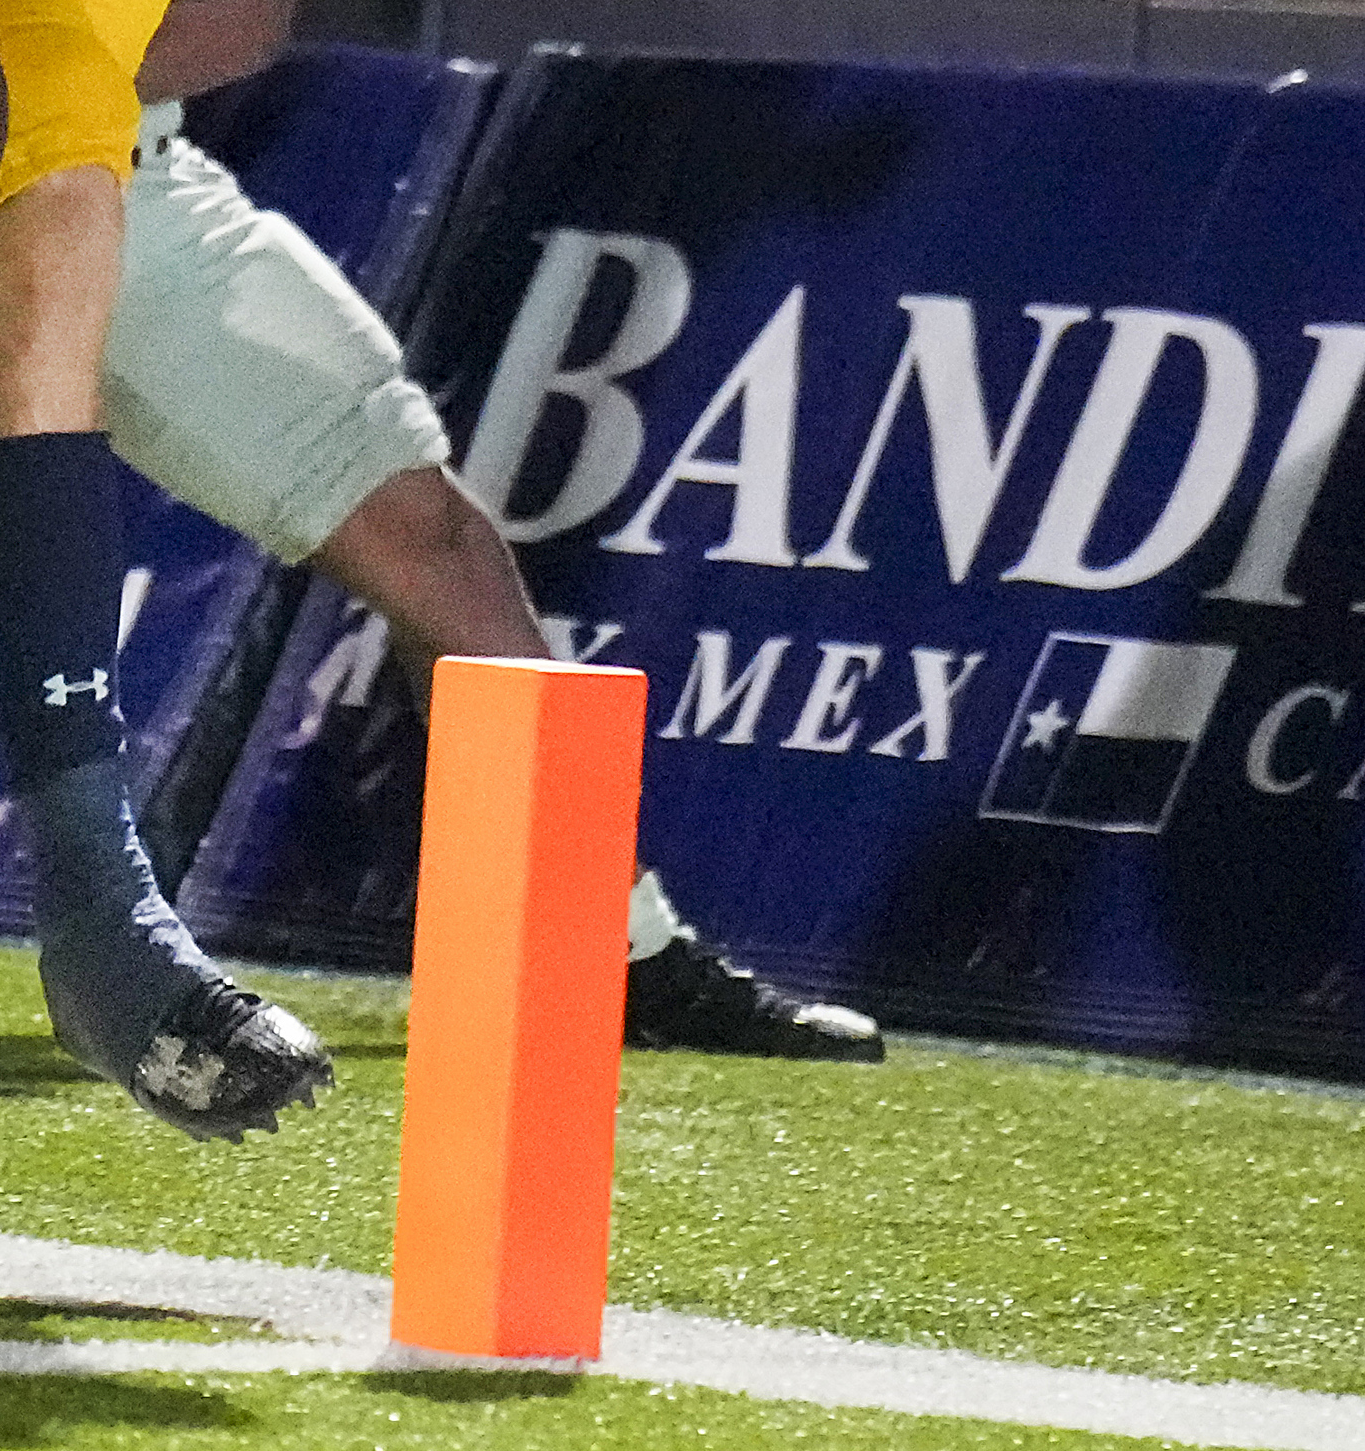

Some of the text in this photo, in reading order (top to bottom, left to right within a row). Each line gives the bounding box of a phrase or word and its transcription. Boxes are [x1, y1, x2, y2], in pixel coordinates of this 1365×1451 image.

[469, 228, 1365, 608] BANDI
[659, 630, 986, 762] MEX
[1246, 682, 1365, 800] C
